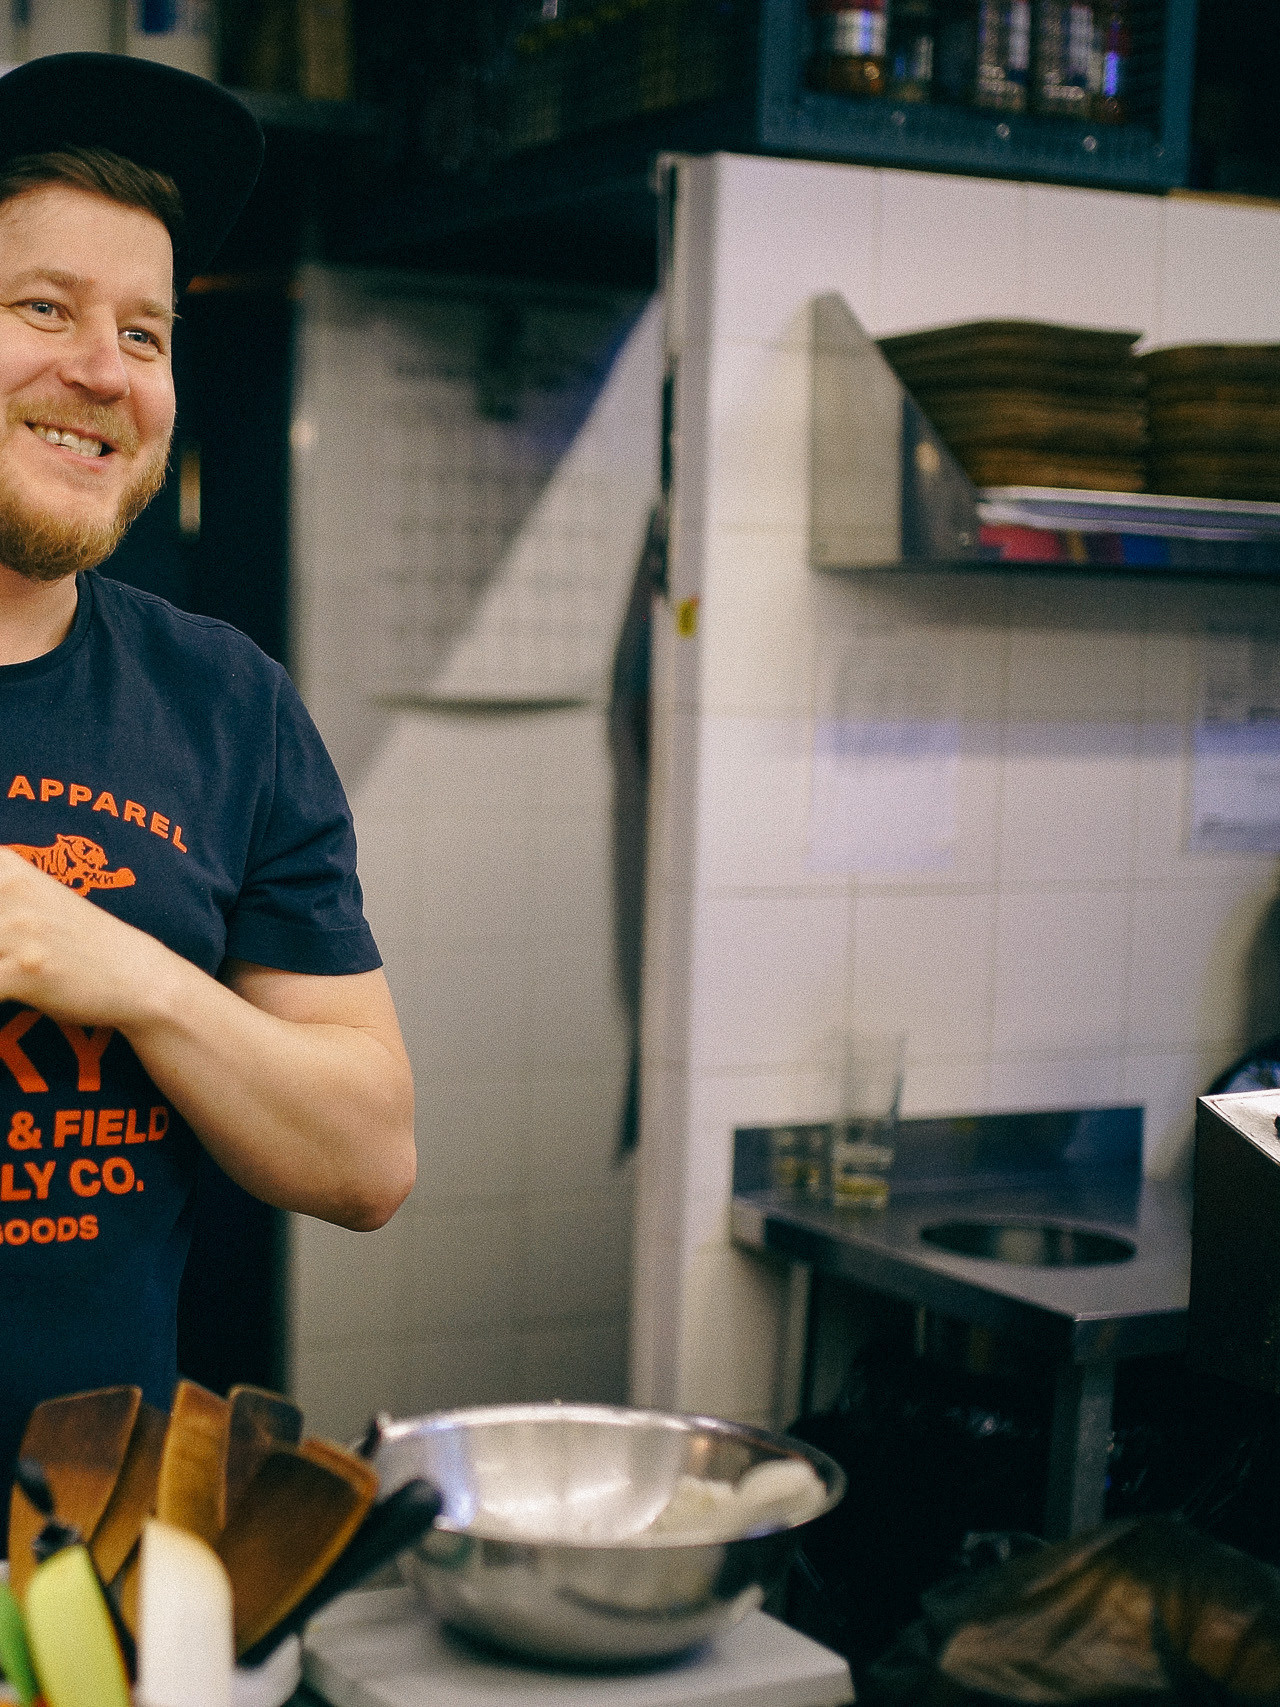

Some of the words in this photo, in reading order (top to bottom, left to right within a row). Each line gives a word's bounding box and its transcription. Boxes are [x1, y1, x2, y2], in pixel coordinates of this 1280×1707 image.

[7, 775, 187, 853] APPAREL
[7, 1111, 43, 1151] &
[53, 1106, 169, 1148] FIELD
[69, 1156, 144, 1197] CO.
